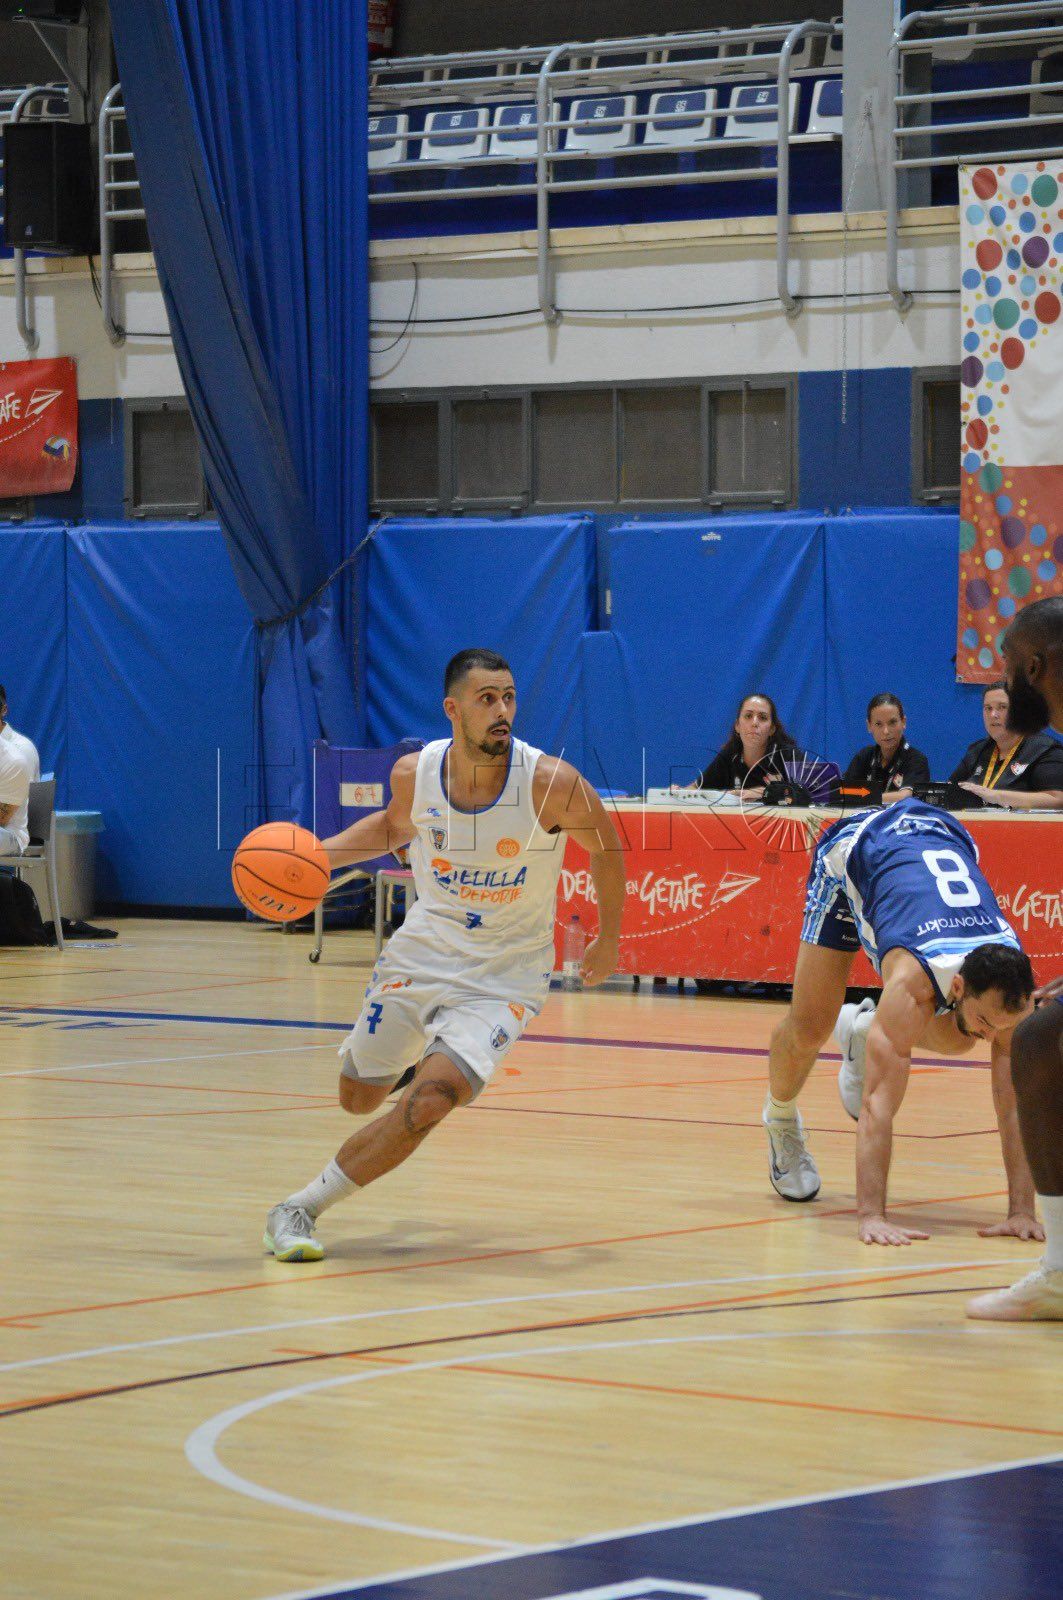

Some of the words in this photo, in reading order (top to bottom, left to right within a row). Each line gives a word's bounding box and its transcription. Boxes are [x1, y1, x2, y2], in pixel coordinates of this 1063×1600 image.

[625, 880, 639, 896] EN
[639, 871, 706, 915] GETAFE
[922, 849, 981, 908] 8
[465, 911, 483, 929] 7
[995, 893, 1011, 910] EN
[1011, 884, 1063, 932] GETA
[366, 1002, 384, 1034] 7
